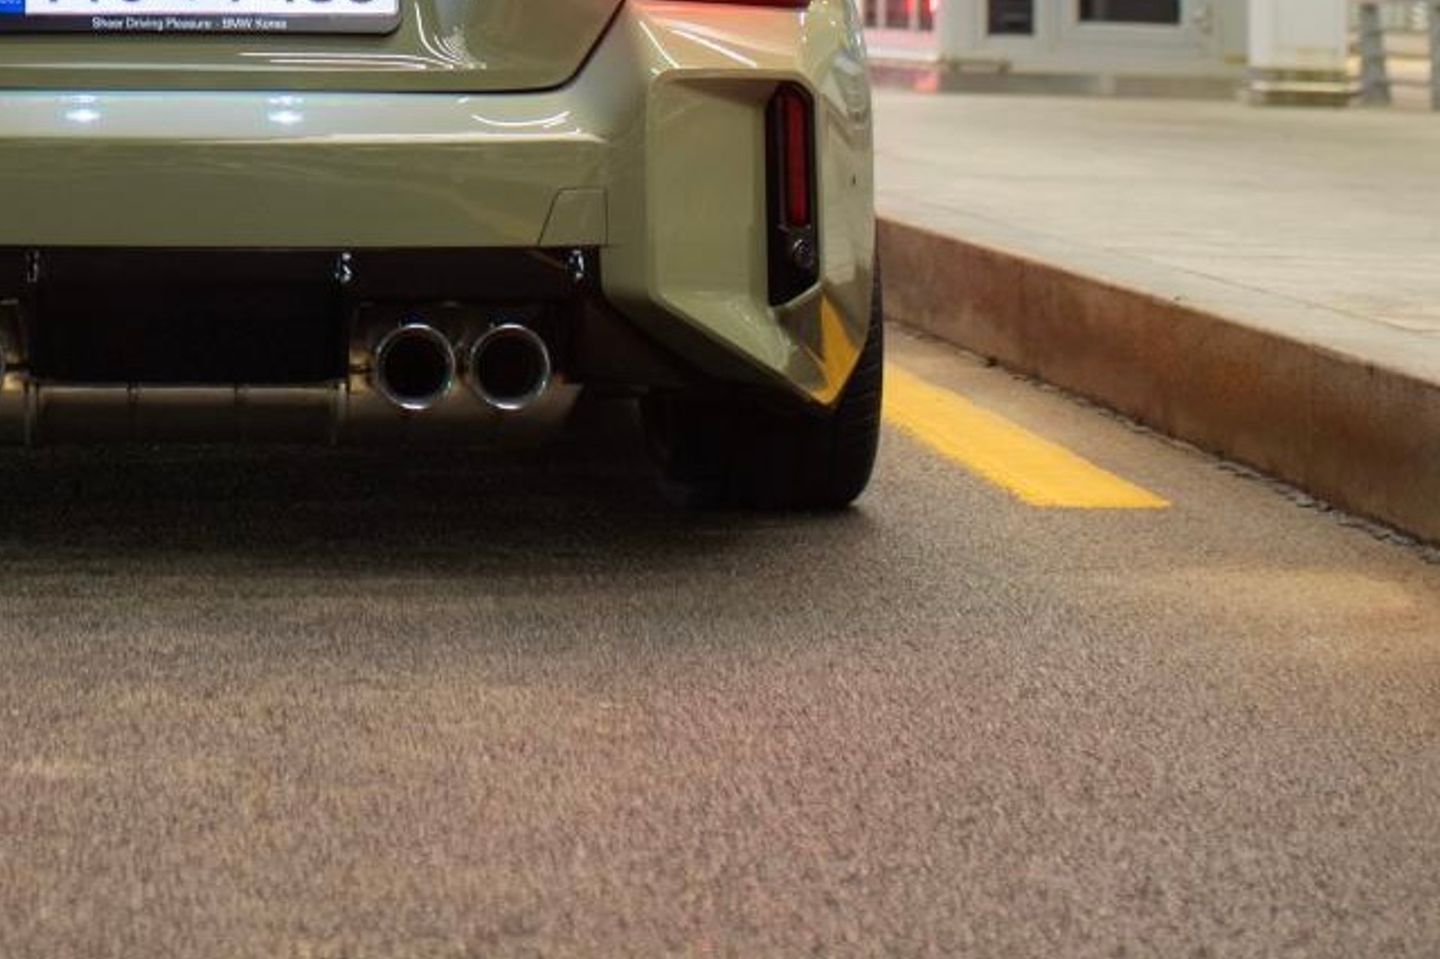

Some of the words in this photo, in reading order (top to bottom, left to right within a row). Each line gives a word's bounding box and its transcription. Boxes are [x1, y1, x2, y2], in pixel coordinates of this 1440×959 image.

[126, 16, 163, 31] Driving
[165, 16, 211, 30] Pleasure
[222, 16, 253, 29] BMW
